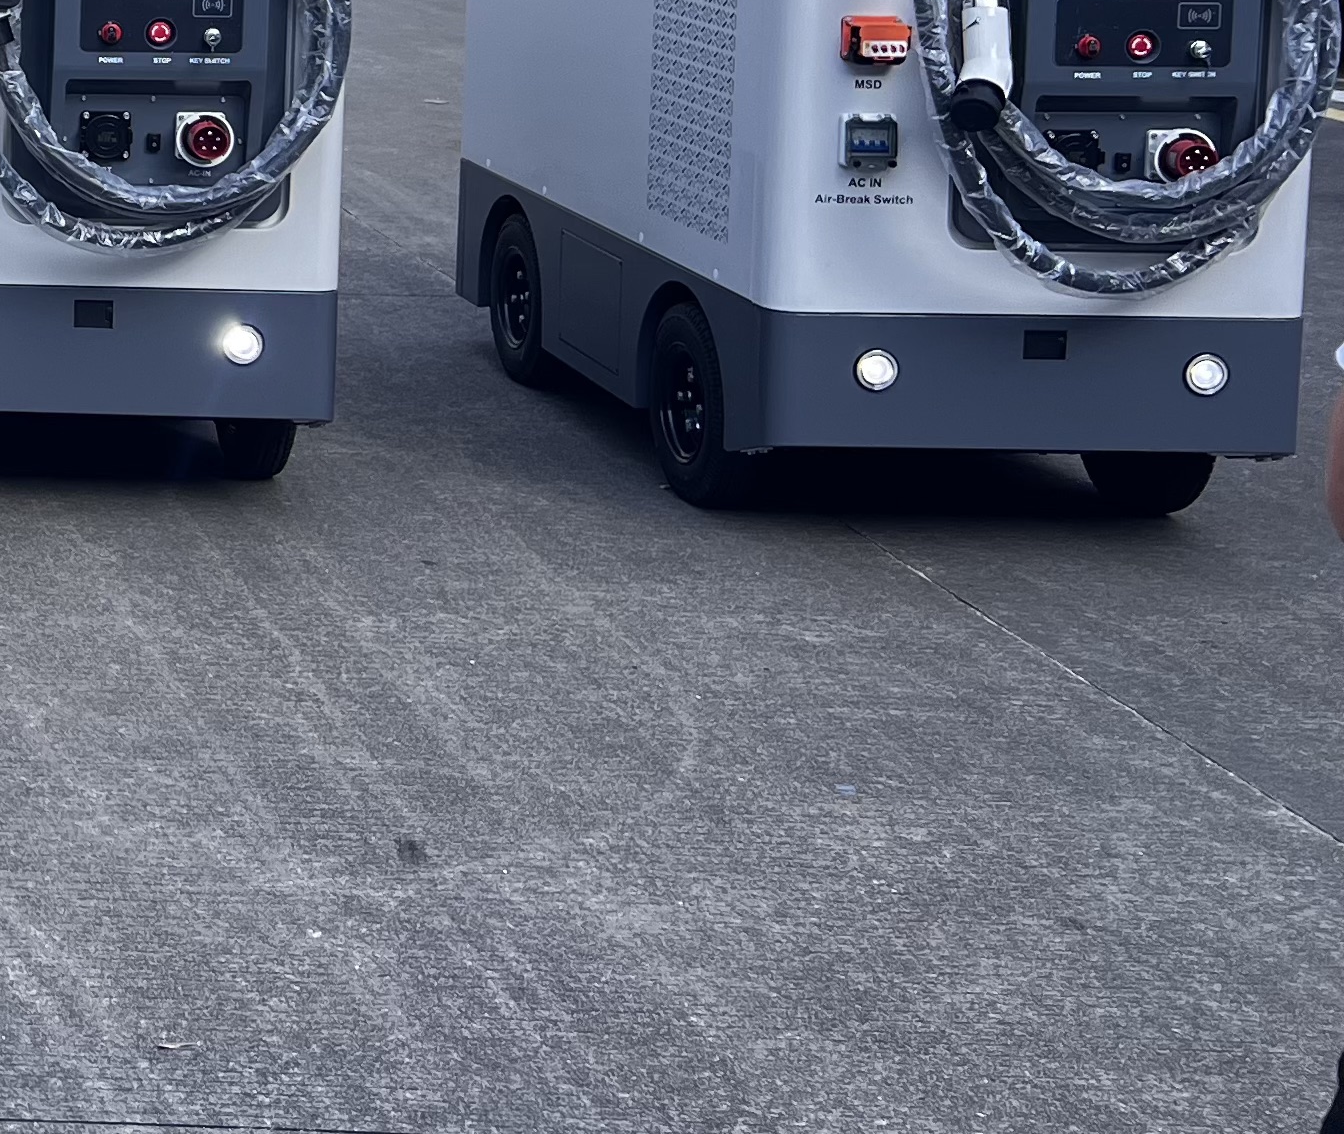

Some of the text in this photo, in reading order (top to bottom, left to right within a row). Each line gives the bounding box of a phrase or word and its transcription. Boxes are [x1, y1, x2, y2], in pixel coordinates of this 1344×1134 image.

[98, 56, 124, 64] POWER
[1073, 71, 1102, 79] POWER
[1132, 71, 1153, 79] STOP
[854, 79, 883, 89] MSD
[187, 169, 212, 177] AC-IN
[848, 177, 882, 188] AC IN
[814, 193, 914, 205] Air-Break Switch
